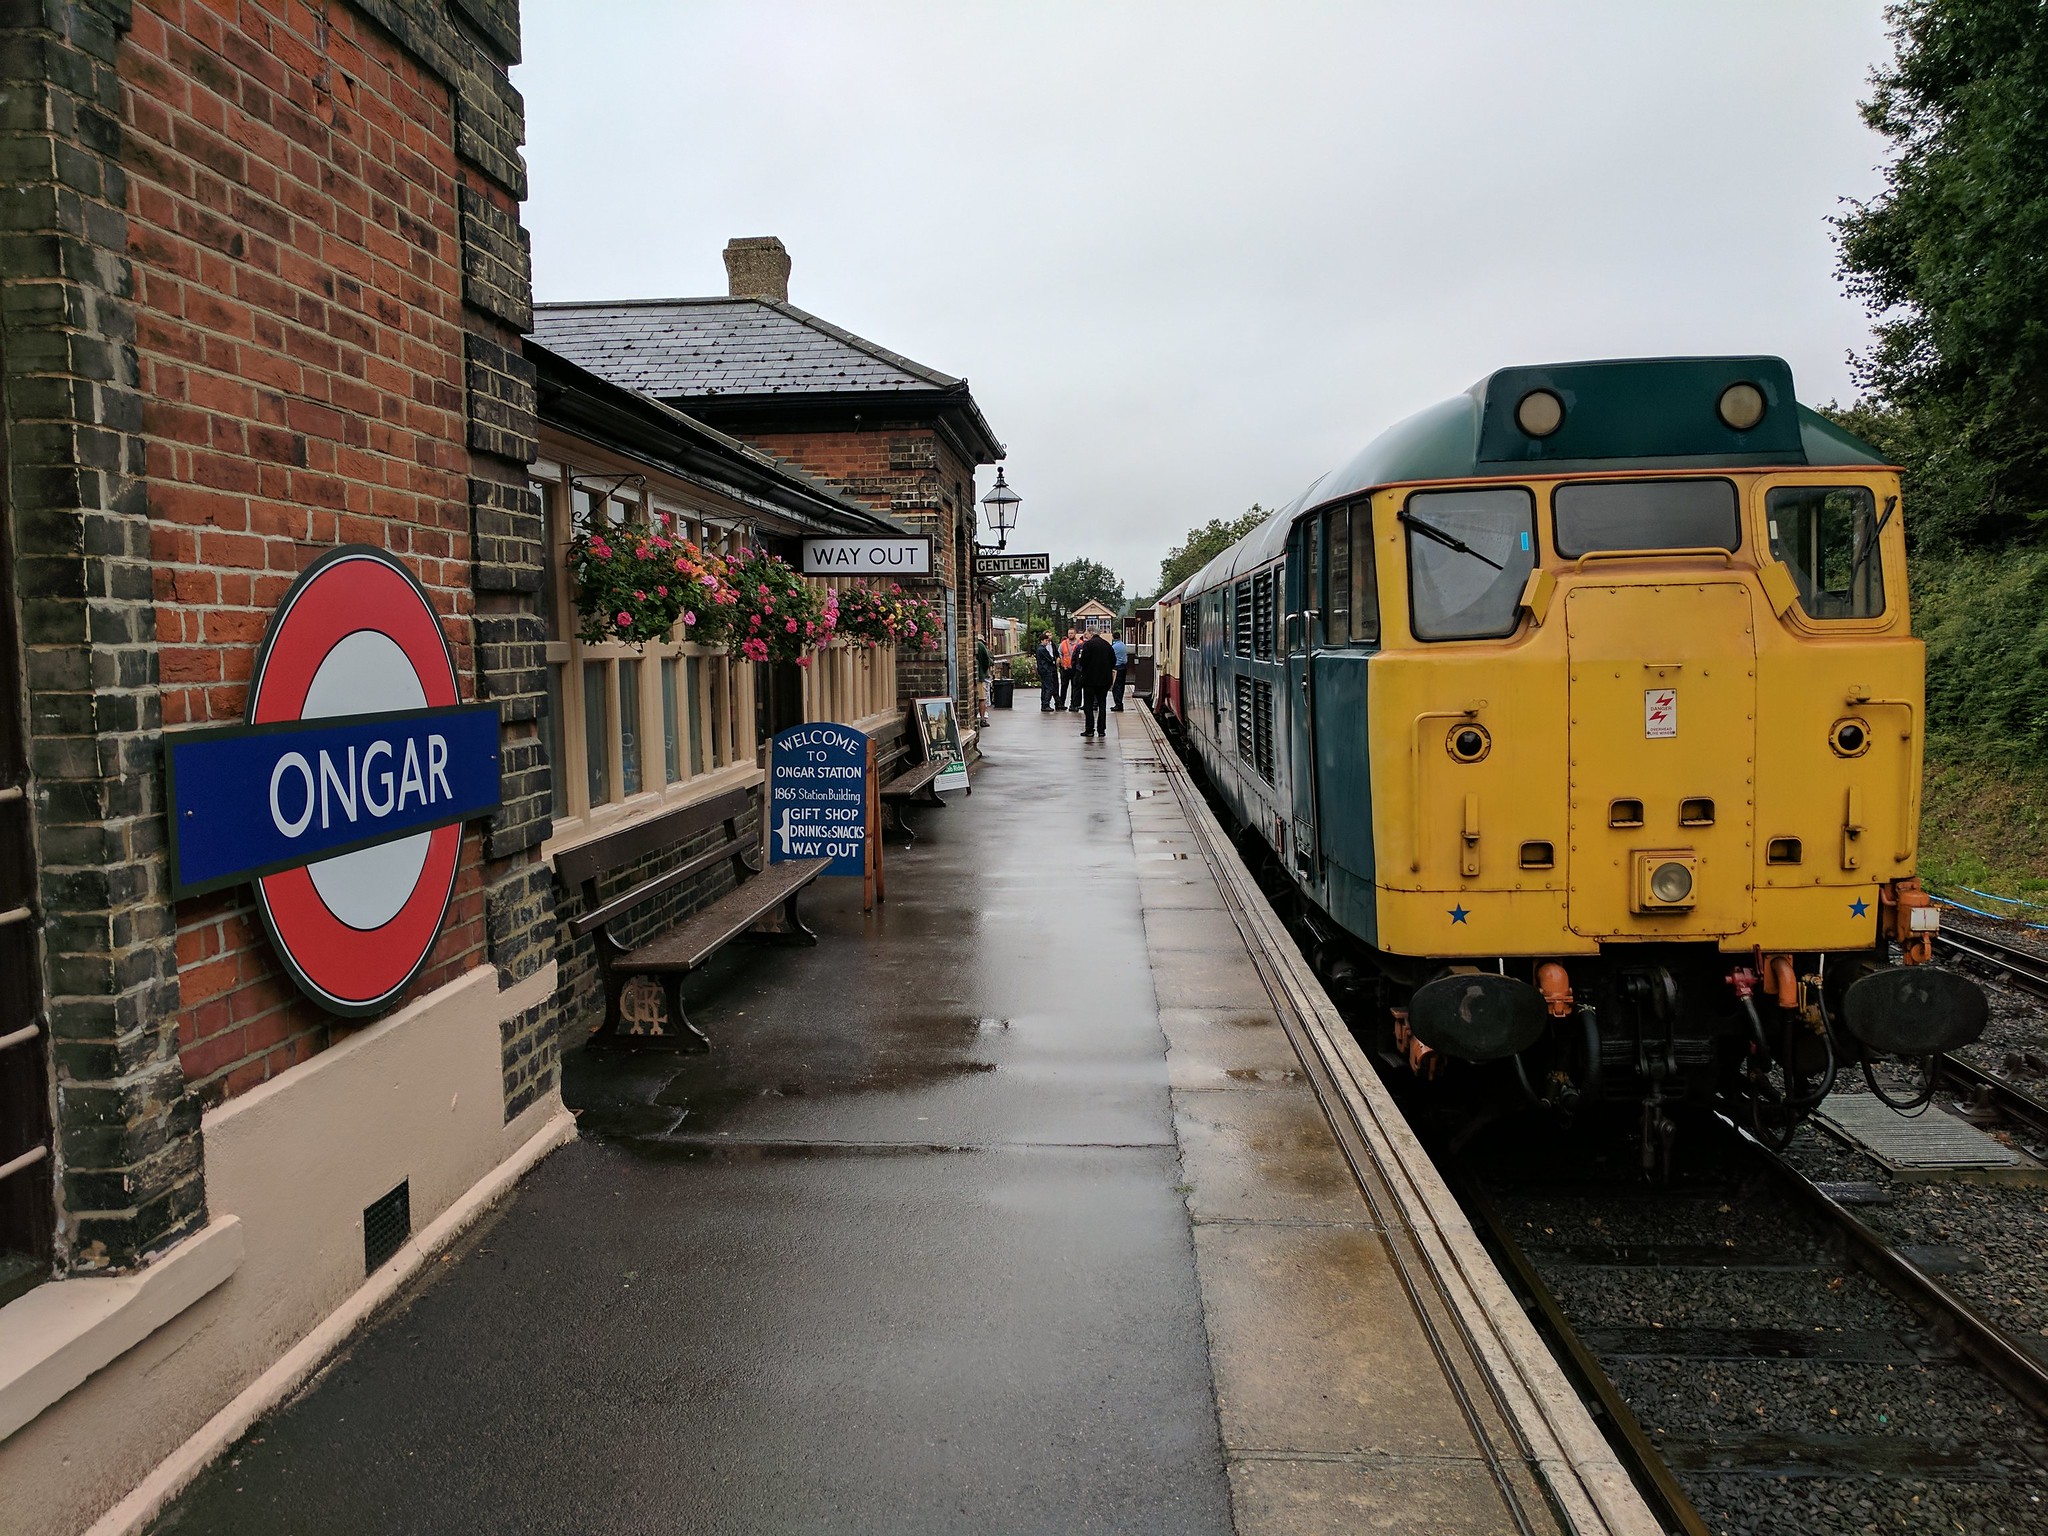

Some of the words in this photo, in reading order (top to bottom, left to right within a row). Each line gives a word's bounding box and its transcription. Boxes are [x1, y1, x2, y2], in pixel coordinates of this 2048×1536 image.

[812, 547, 861, 565] WAY
[868, 547, 919, 565] OUT
[977, 558, 1045, 571] GENTLEMEN
[778, 729, 860, 756] WELCOME
[806, 750, 827, 762] TO
[776, 766, 815, 778] ONGAR
[817, 766, 861, 778] STATION
[269, 734, 453, 838] ONGAR
[774, 787, 796, 800] 1865
[798, 787, 828, 801] Station
[828, 788, 861, 806] Building
[790, 808, 821, 820] GIFT
[825, 808, 859, 821] SHOP
[791, 842, 822, 855] WAY
[826, 843, 859, 858] OUT
